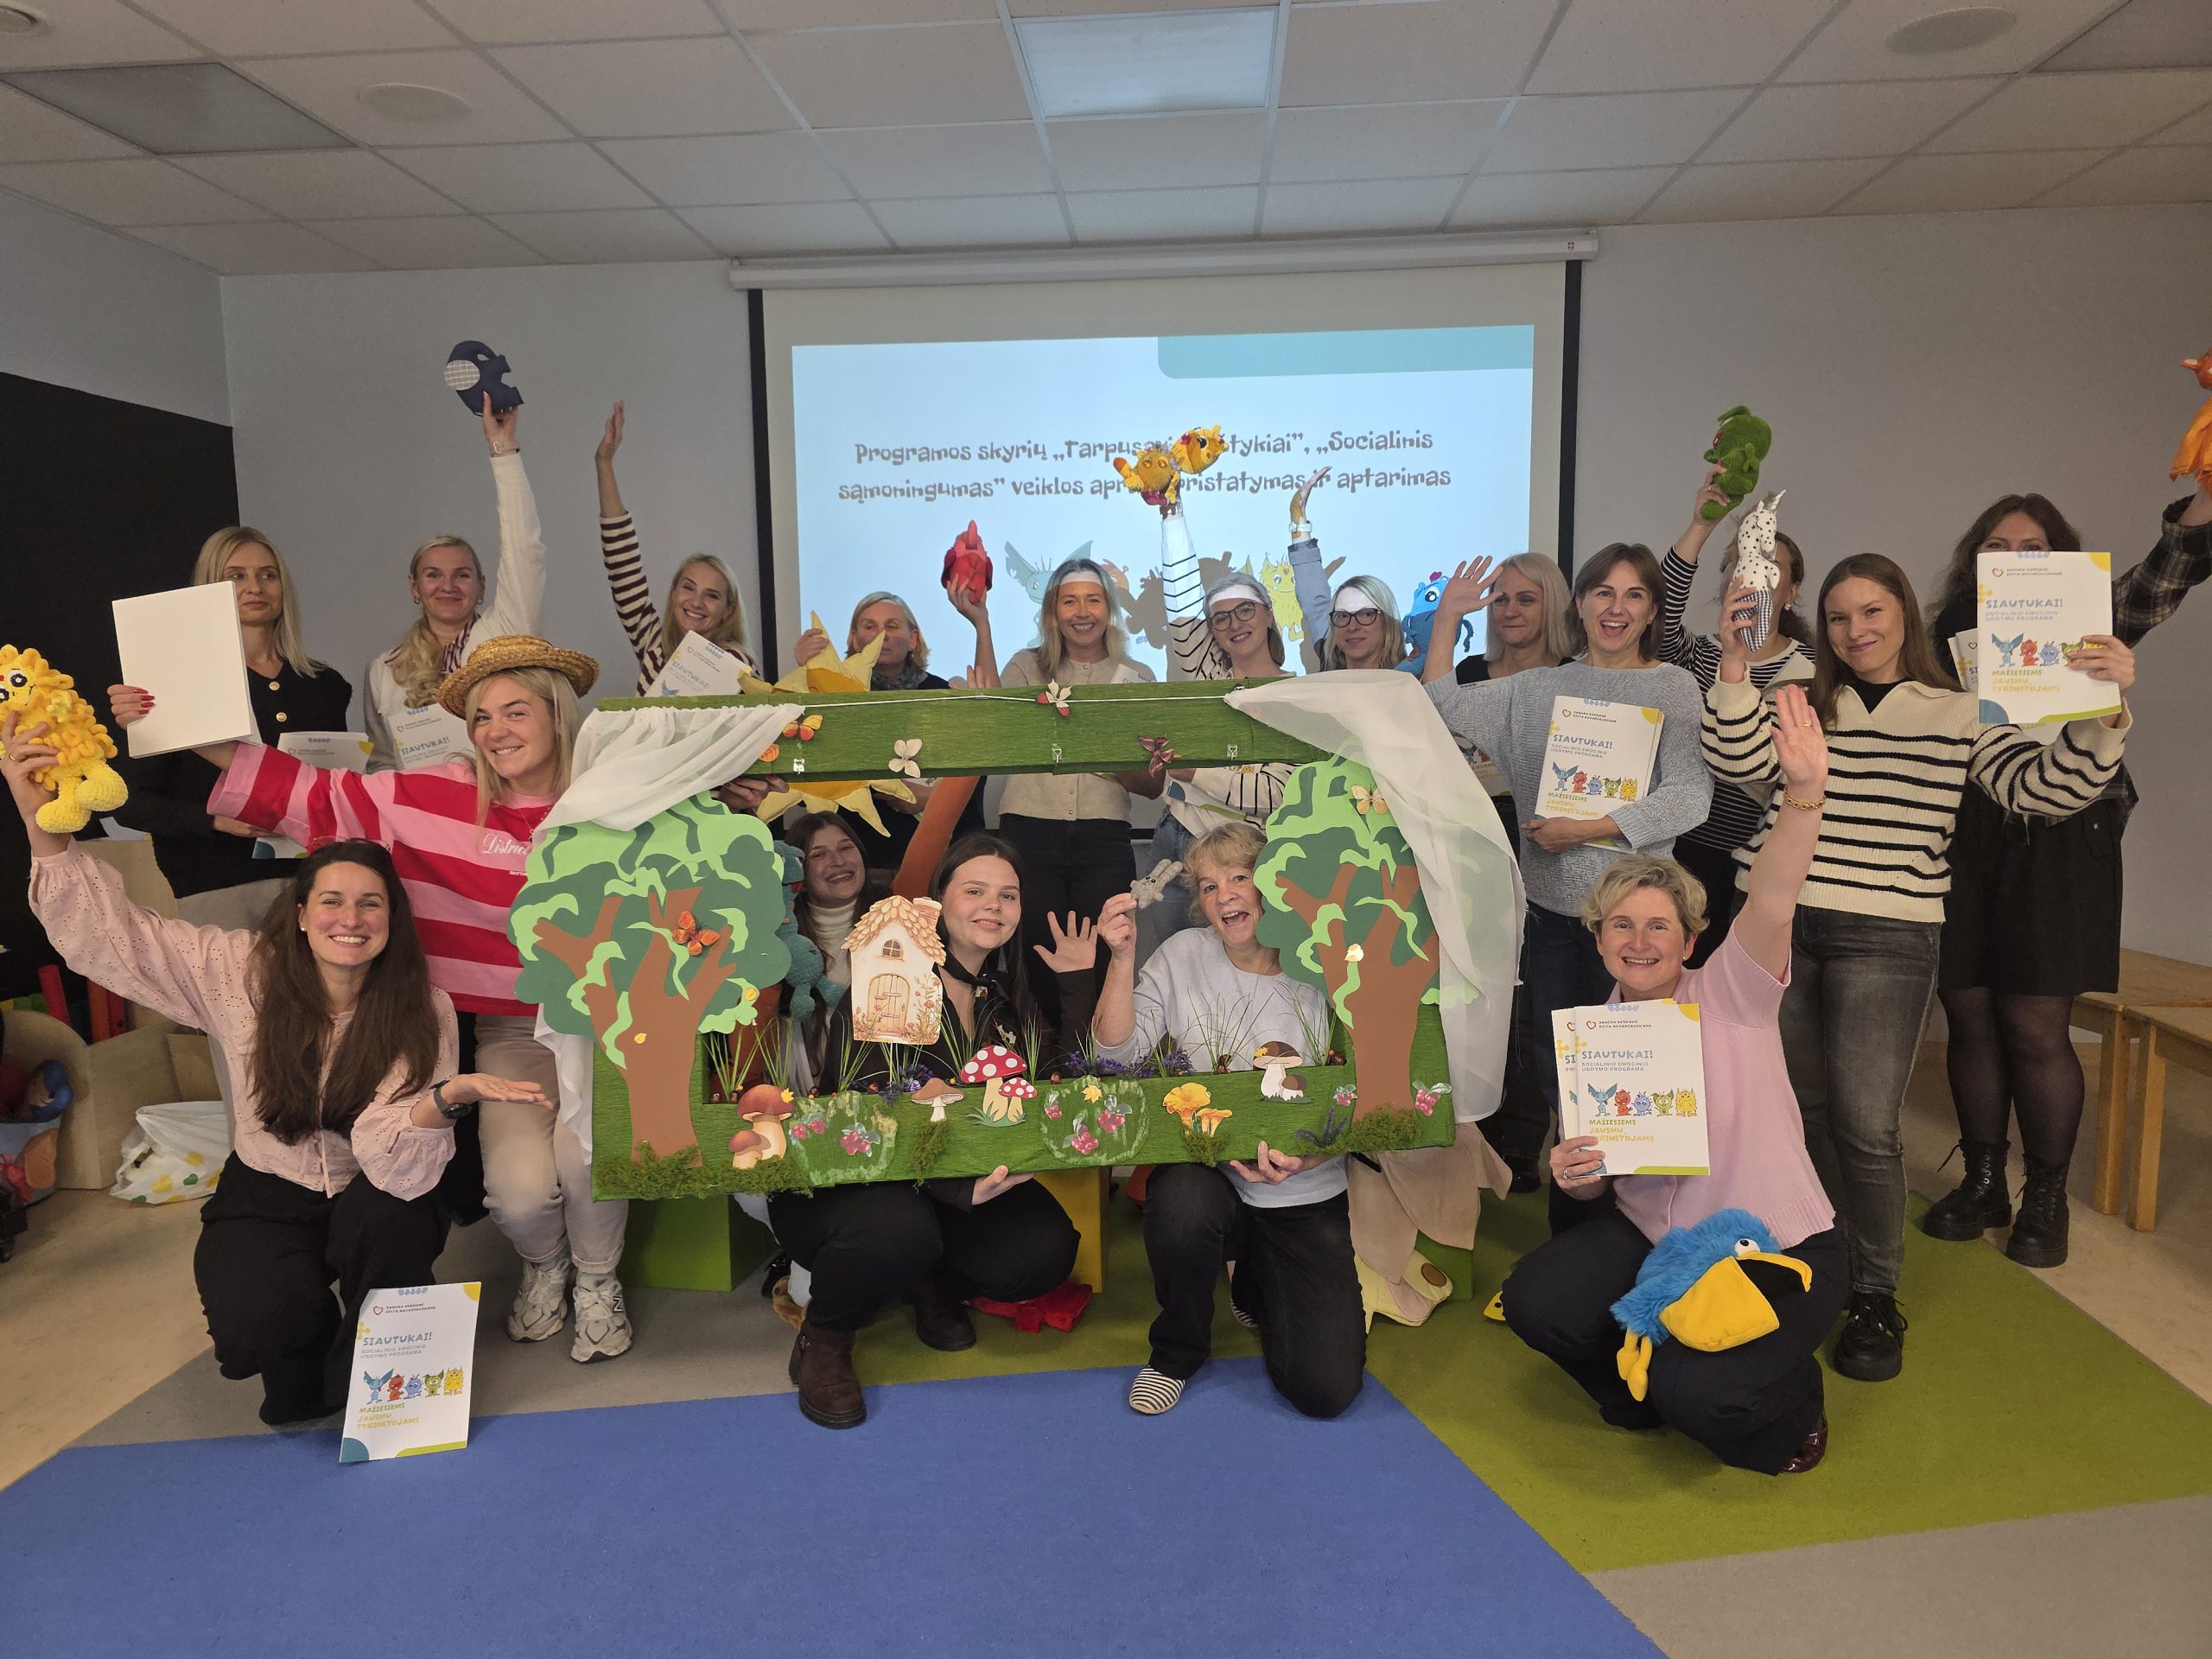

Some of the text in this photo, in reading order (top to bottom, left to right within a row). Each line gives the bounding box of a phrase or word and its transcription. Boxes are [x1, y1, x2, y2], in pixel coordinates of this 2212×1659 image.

[855, 443, 971, 466] Programos
[978, 440, 1046, 463] skyrių
[1316, 429, 1433, 454] „Socialinis
[838, 478, 1005, 504] sąmoningumas”
[1012, 477, 1084, 496] veiklos
[1338, 468, 1452, 493] aptarimas
[1986, 598, 2063, 608] SIAUTUKAI!
[1554, 734, 1612, 749] SIAUTUKAI!
[1581, 1050, 1653, 1059] SIAUTUKAI!
[363, 1332, 432, 1346] SIAUTUKAI!
